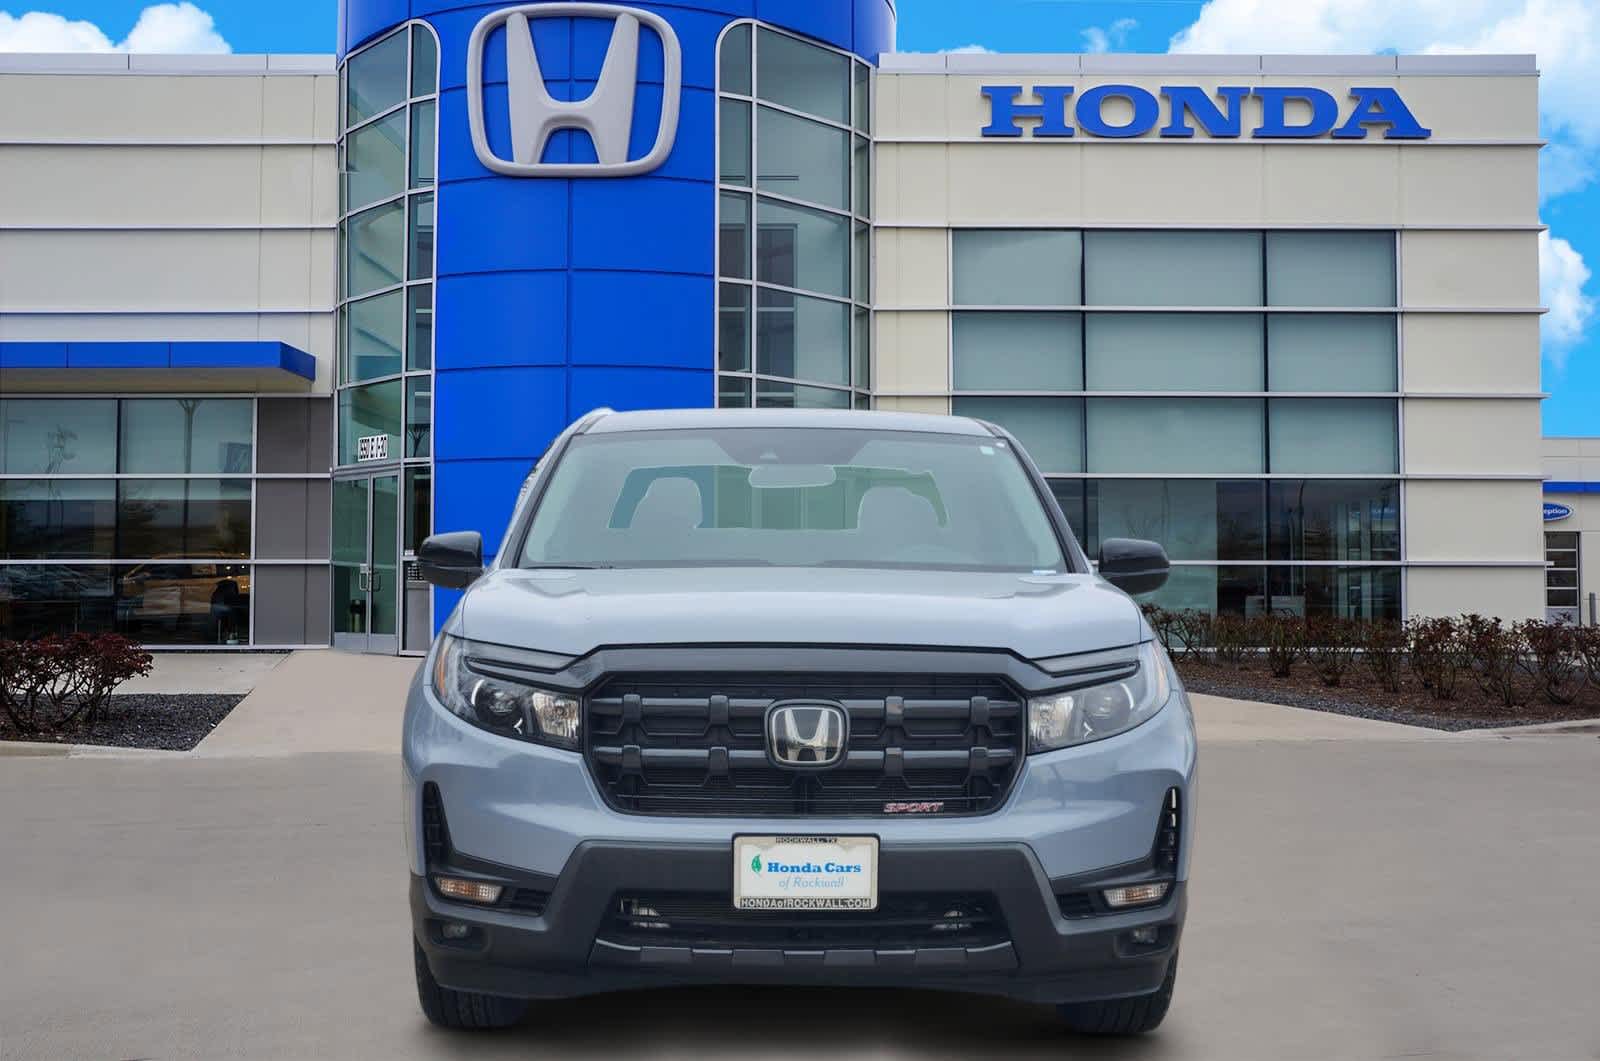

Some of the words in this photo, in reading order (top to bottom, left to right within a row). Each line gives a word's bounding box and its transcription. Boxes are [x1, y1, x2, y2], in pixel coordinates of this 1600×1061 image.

[980, 84, 1432, 139] HONDA
[883, 802, 944, 812] SPORT
[767, 862, 821, 873] Honda
[824, 862, 861, 873] Cars
[778, 877, 790, 889] of
[793, 876, 845, 887] Rockwall
